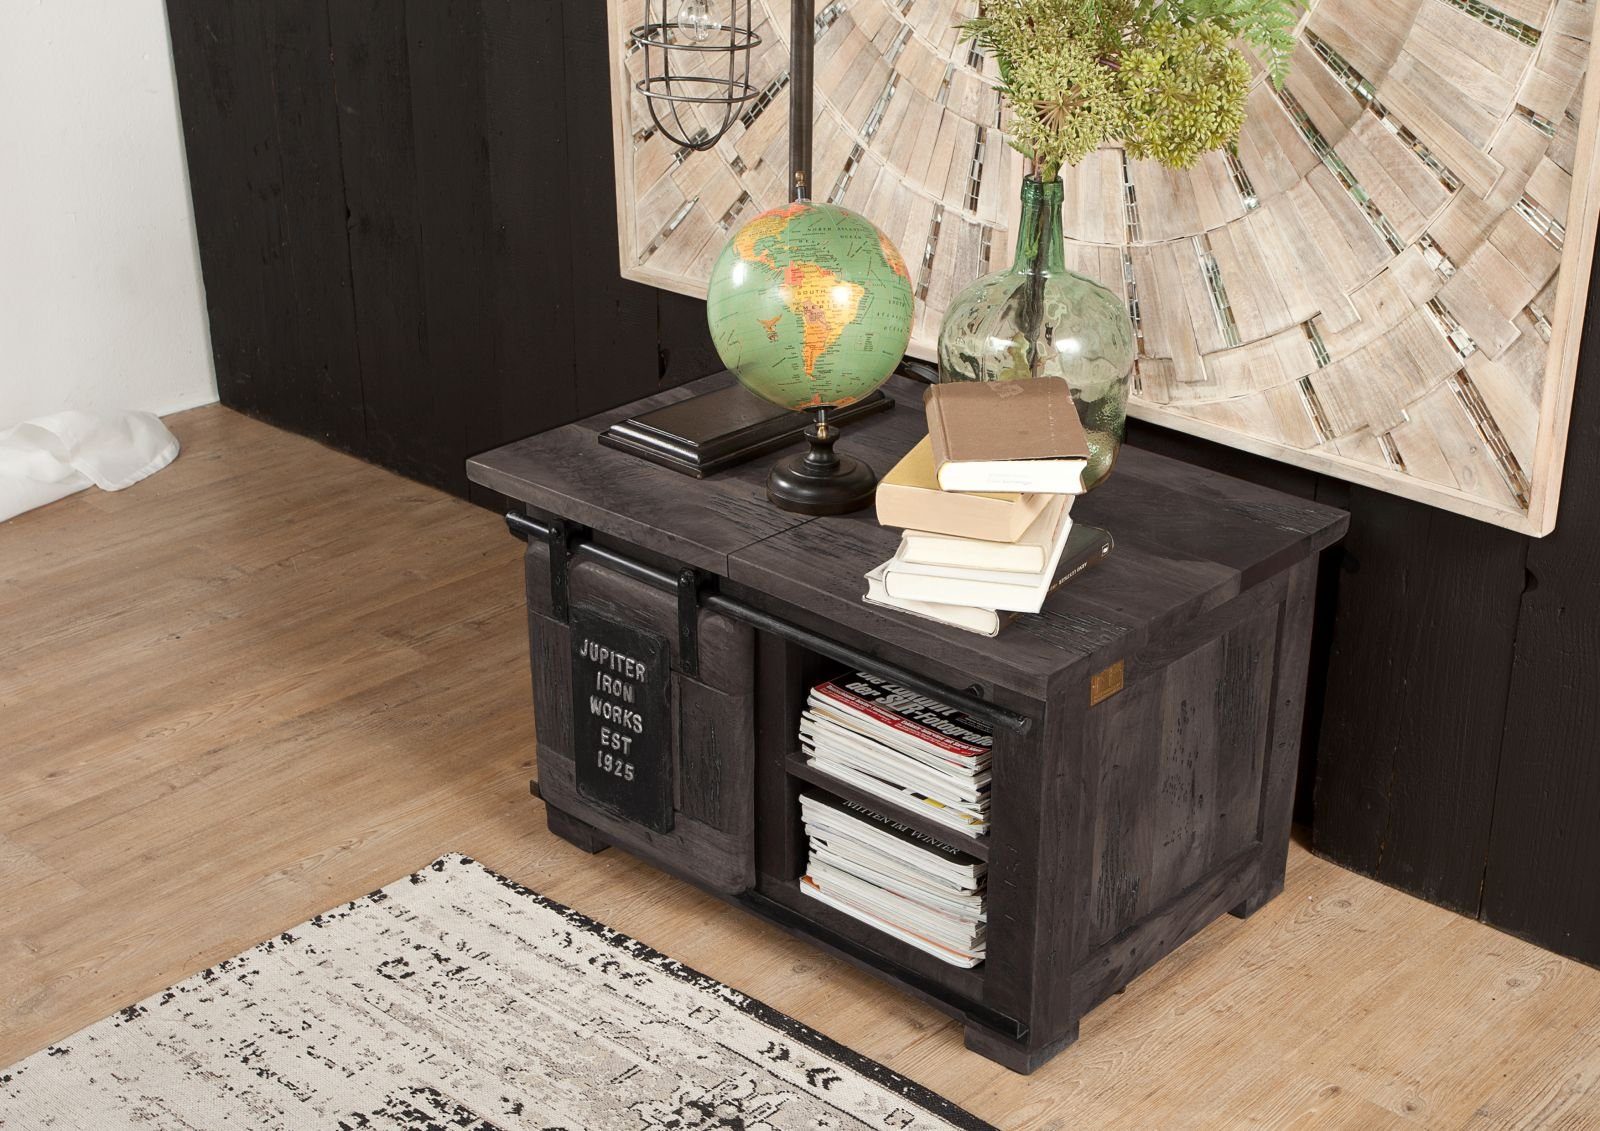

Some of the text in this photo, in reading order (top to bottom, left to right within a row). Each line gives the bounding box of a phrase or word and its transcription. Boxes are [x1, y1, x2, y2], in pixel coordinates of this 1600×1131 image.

[580, 638, 646, 682] JUPITER
[596, 671, 634, 703] IRON
[845, 682, 881, 696] der
[590, 695, 643, 733] WORKS
[600, 727, 633, 755] EST
[597, 750, 635, 781] 1925
[842, 800, 961, 855] MITTEN IM WINTER
